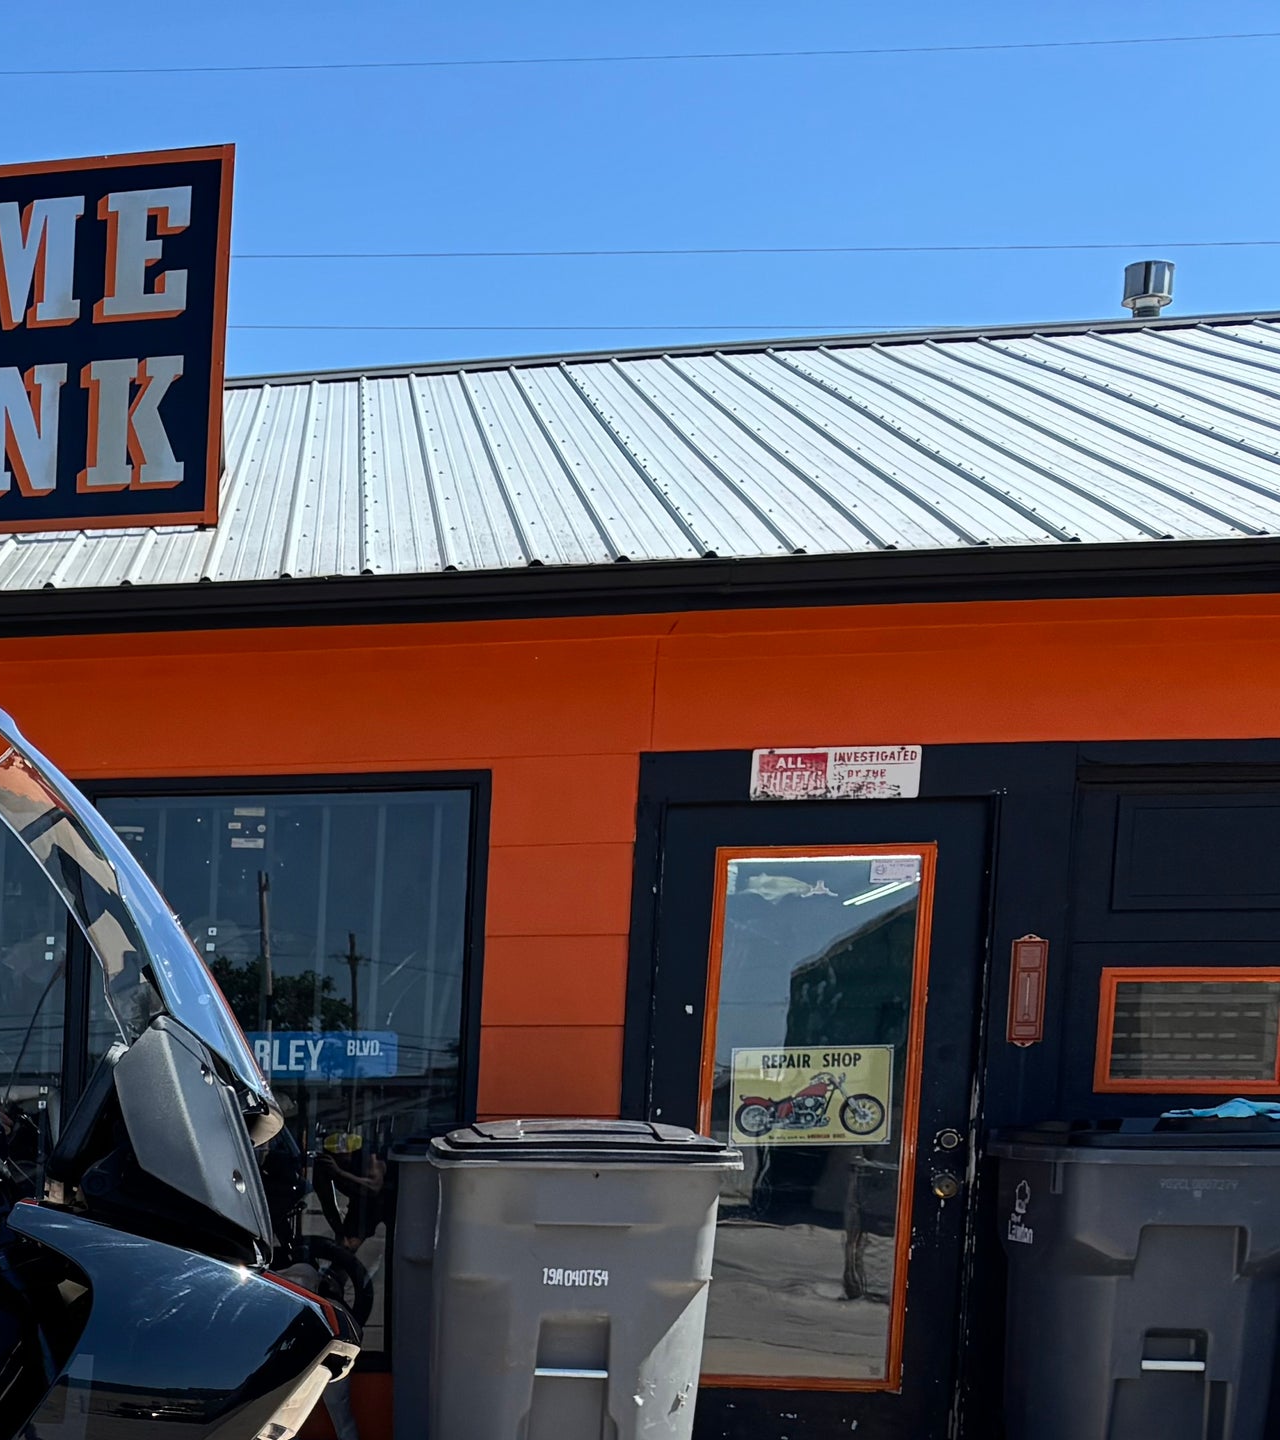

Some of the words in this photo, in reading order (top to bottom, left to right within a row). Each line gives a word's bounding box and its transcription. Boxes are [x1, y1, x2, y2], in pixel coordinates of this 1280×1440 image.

[776, 757, 806, 769] ALL
[834, 750, 917, 763] INVESTIGATED
[346, 1040, 384, 1056] BLVD.
[762, 1054, 811, 1069] REPAIR
[822, 1052, 862, 1067] SHOP
[542, 1267, 609, 1287] 19A040754
